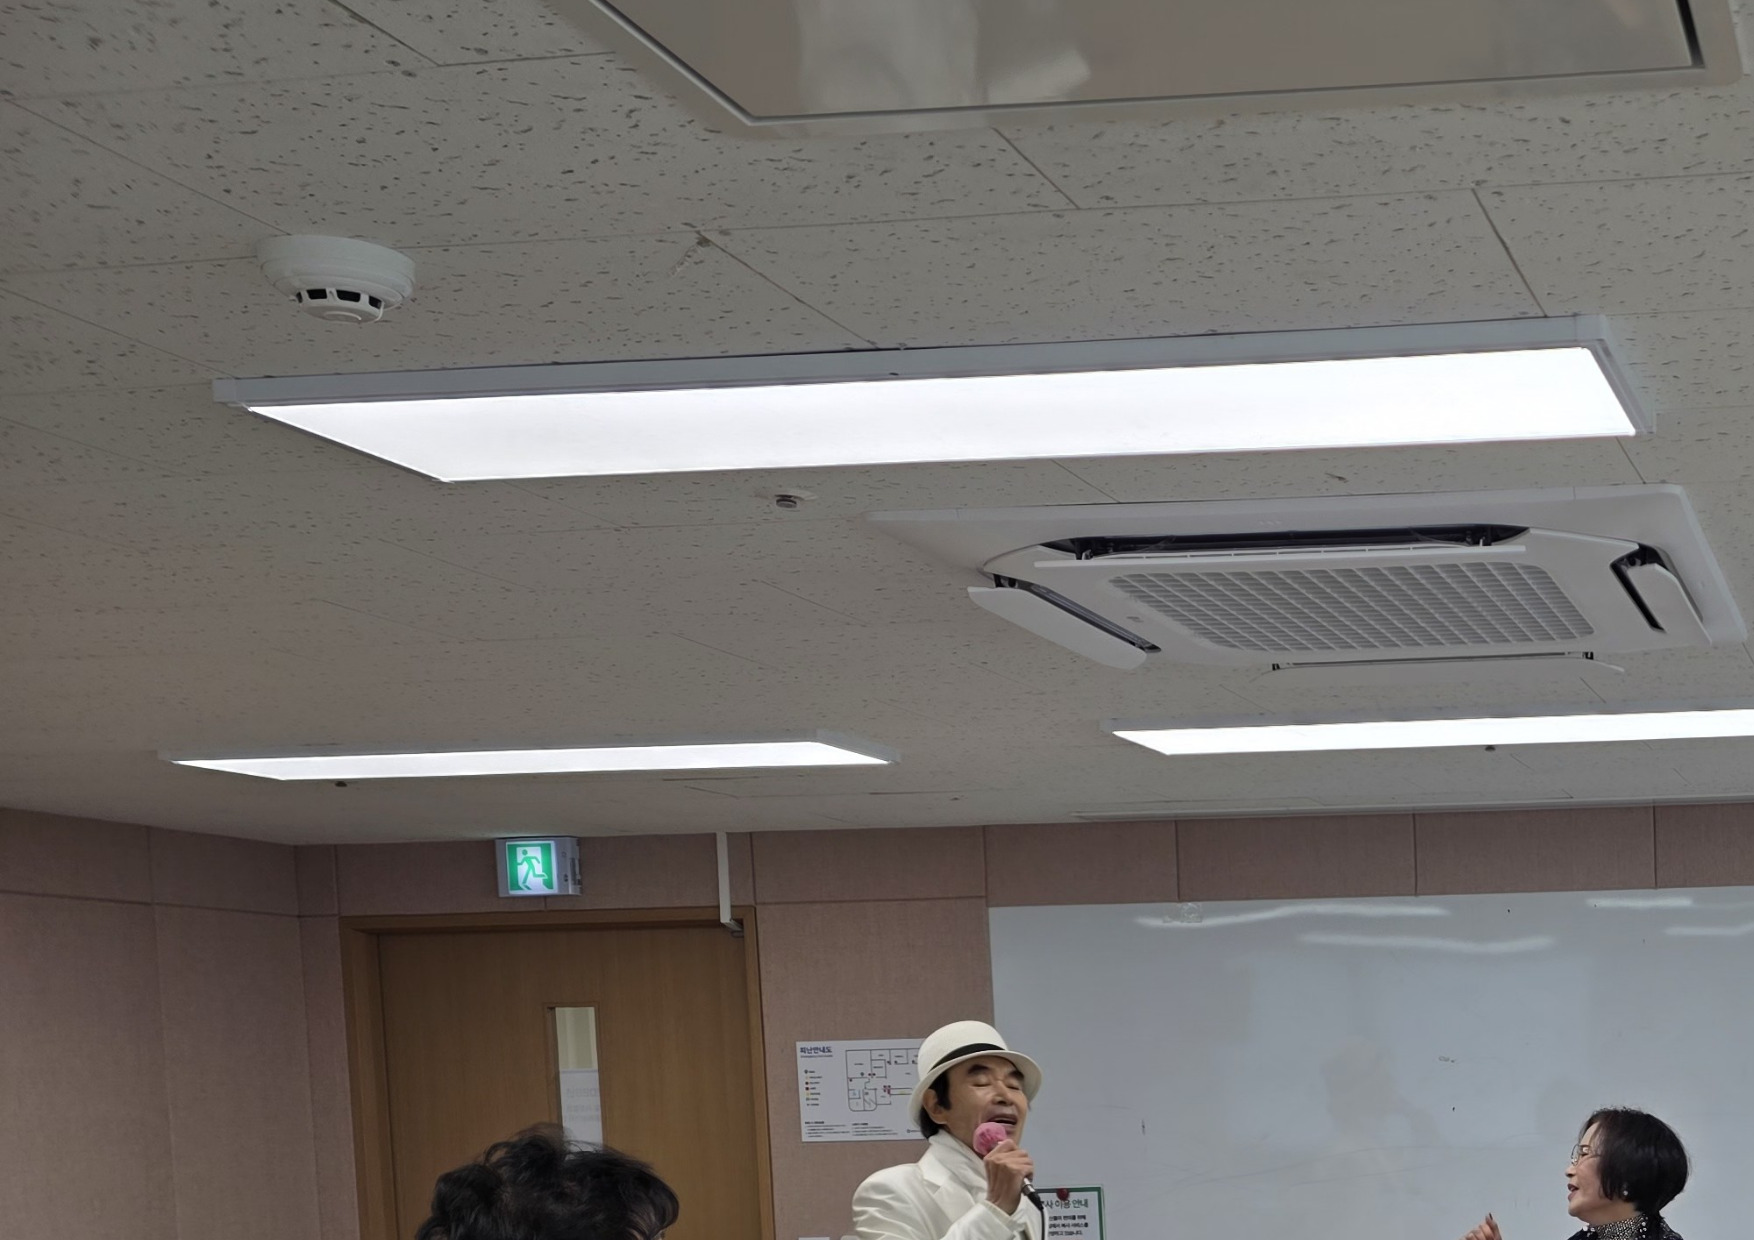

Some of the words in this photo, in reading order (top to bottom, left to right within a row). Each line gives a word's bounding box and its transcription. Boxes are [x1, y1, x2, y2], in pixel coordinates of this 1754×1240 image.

[800, 1046, 832, 1054] 피난안내도
[1042, 1199, 1053, 1209] 사
[1055, 1199, 1071, 1209] 이용
[1072, 1198, 1088, 1209] 안내
